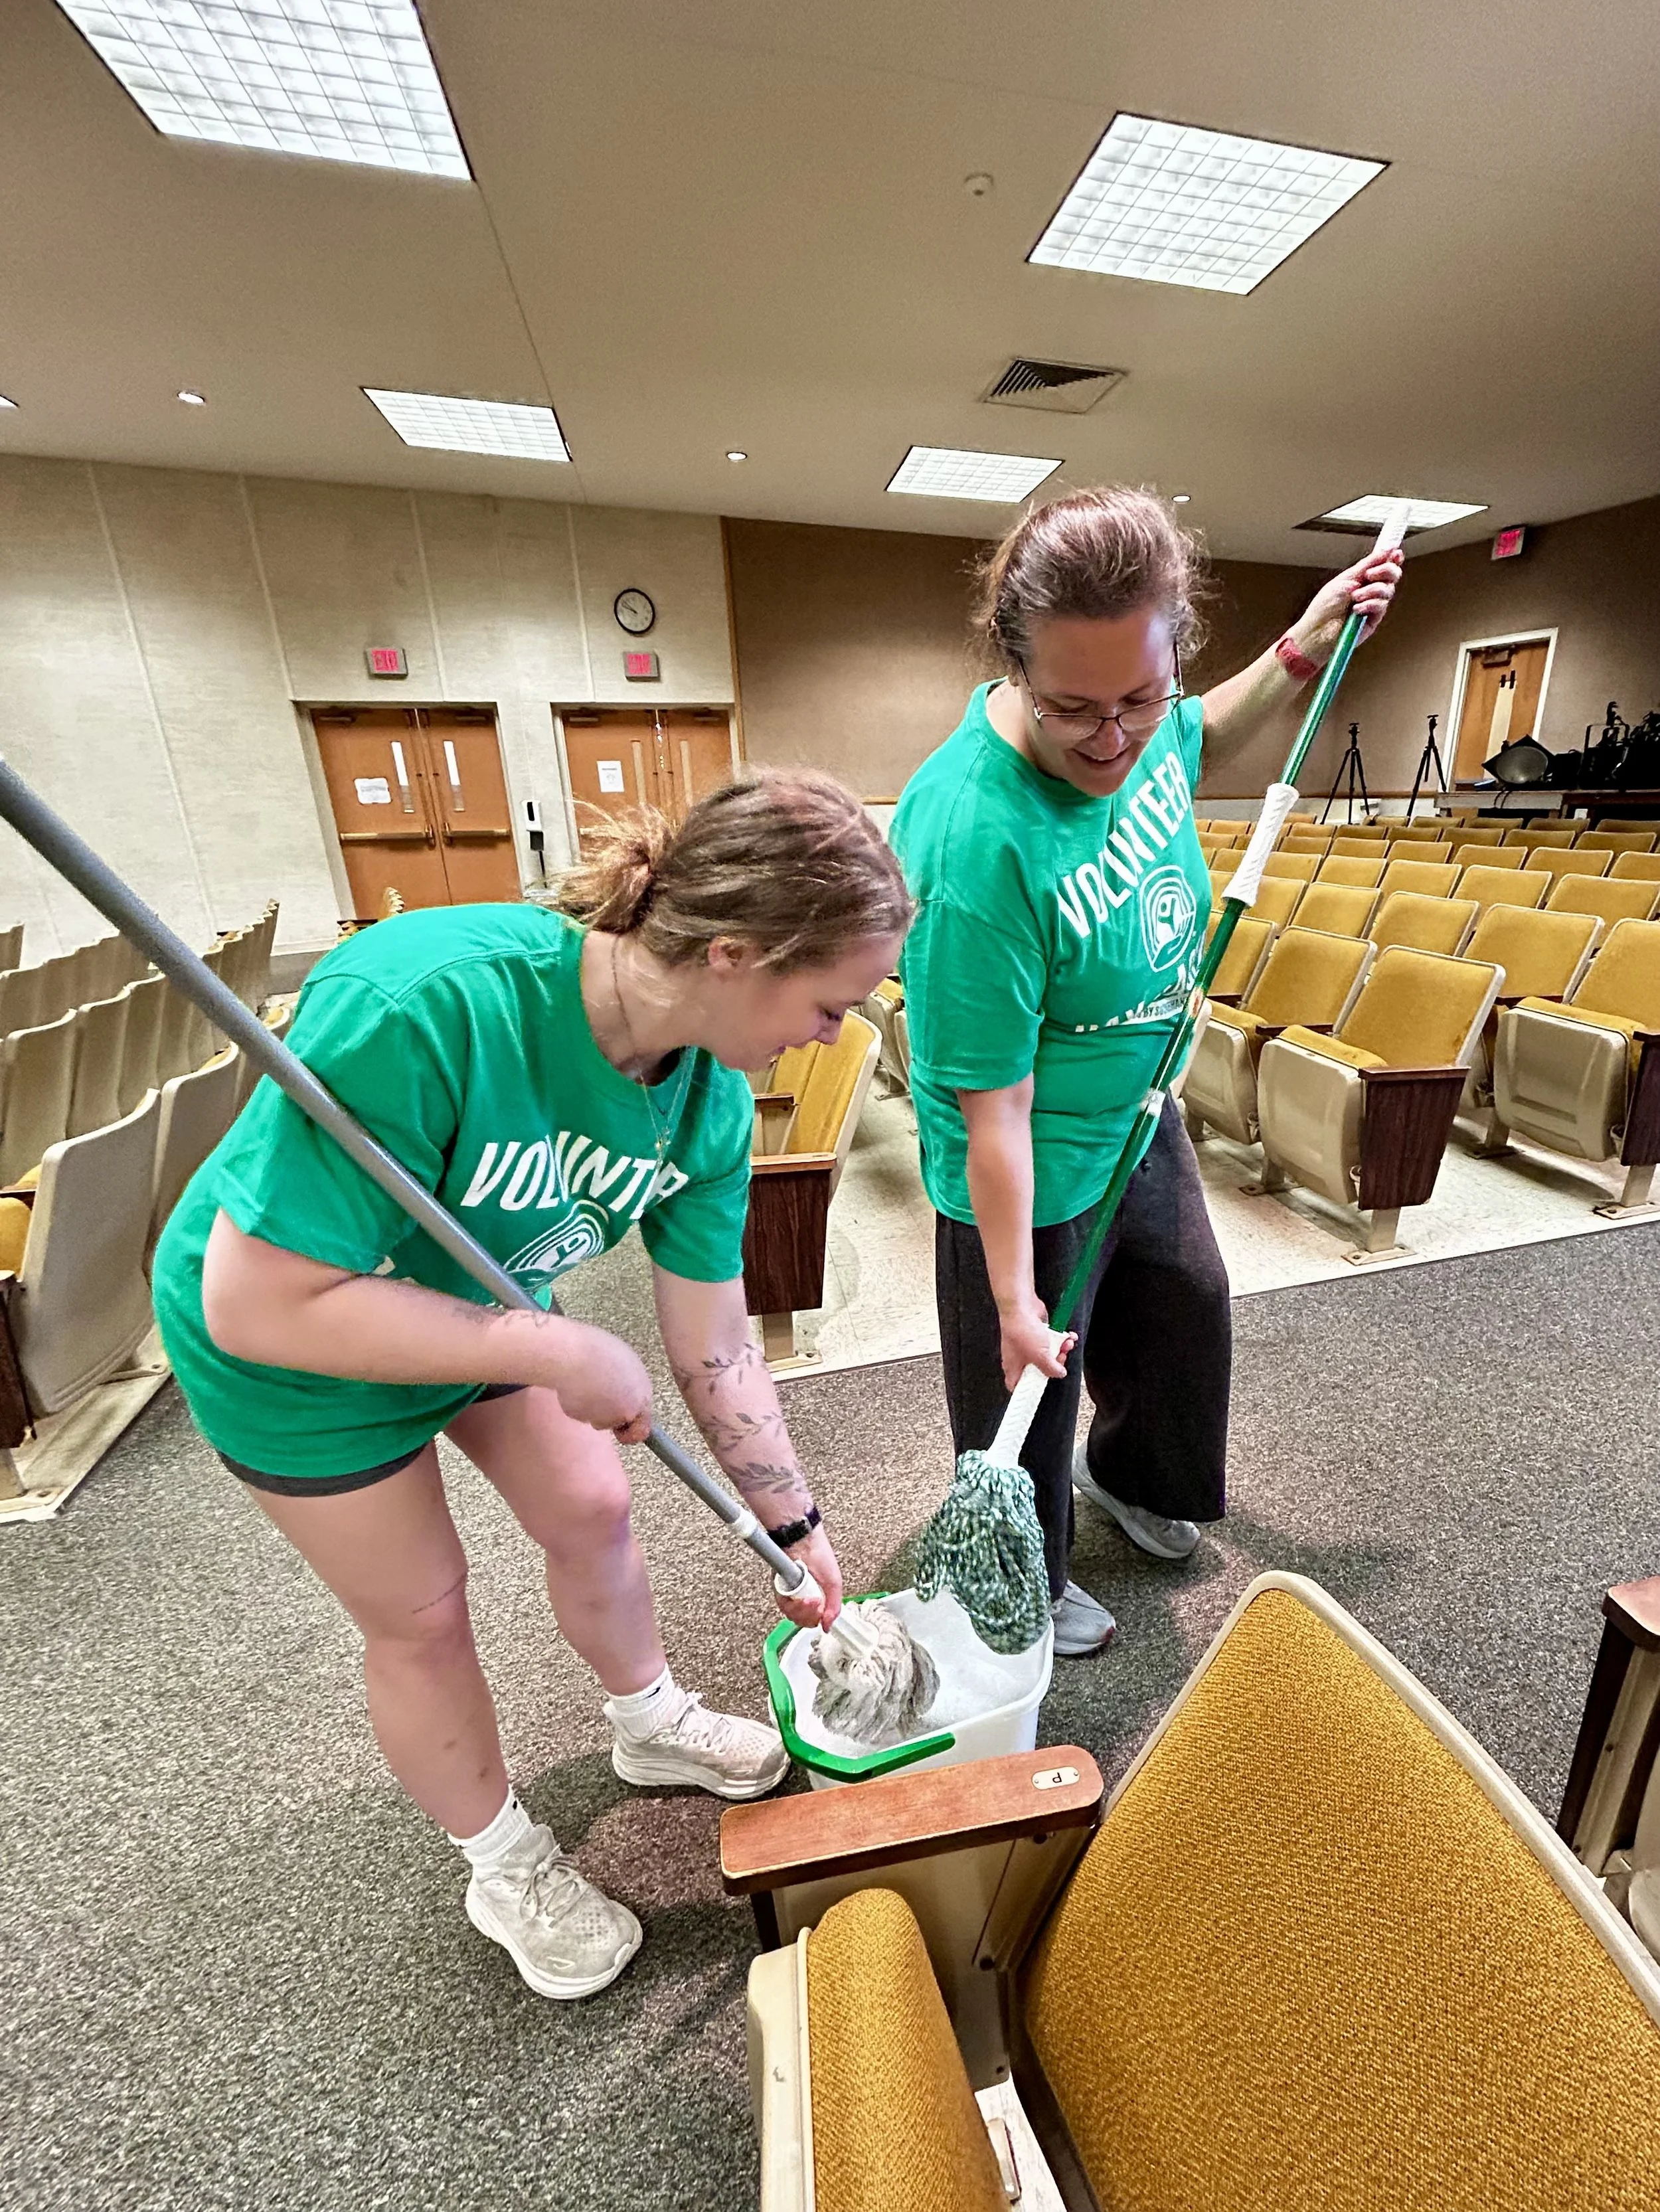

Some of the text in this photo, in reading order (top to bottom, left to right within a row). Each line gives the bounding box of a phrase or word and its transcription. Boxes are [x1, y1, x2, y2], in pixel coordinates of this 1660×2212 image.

[1057, 751, 1191, 939] VOLUNTEER
[459, 1130, 689, 1220] VOLUNTR
[1052, 1772, 1062, 1783] P
